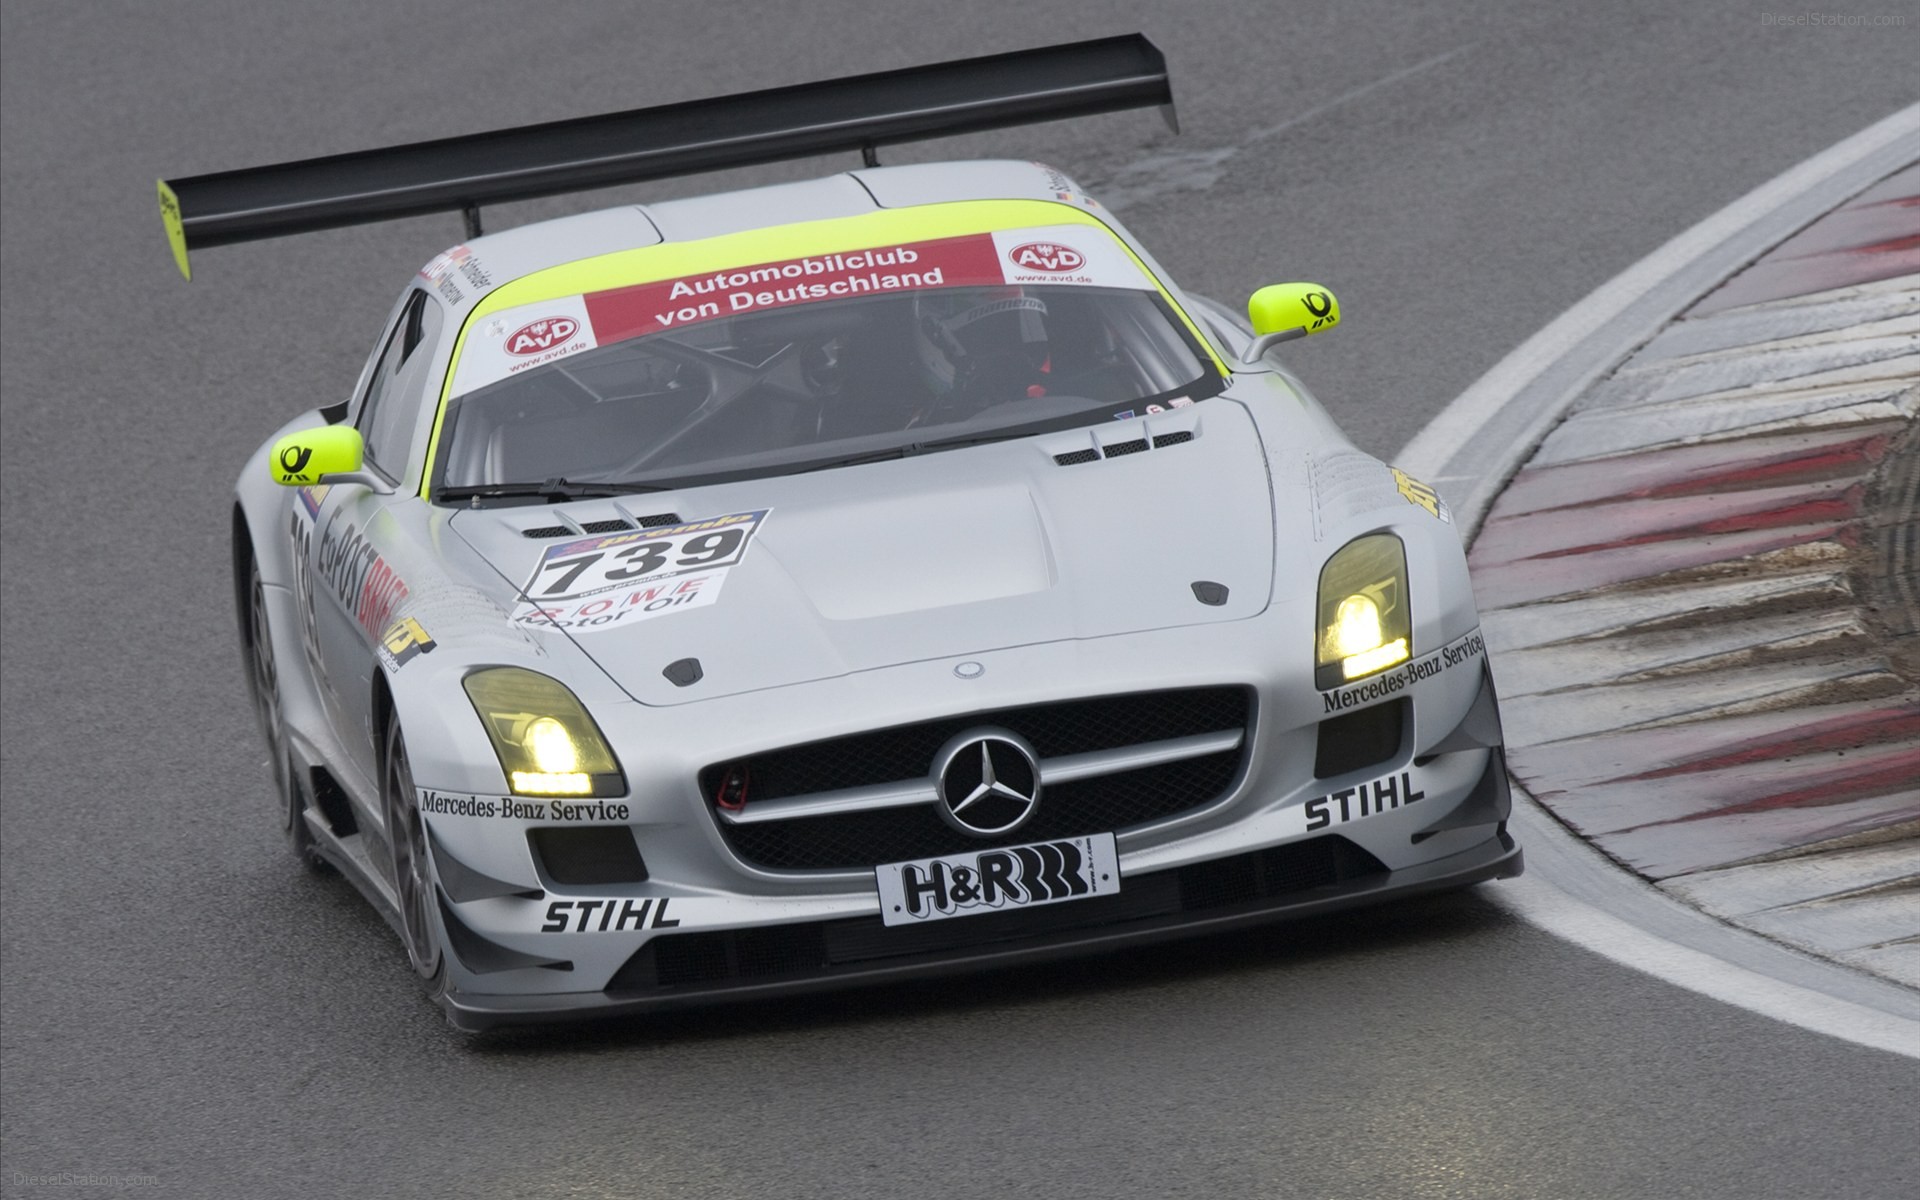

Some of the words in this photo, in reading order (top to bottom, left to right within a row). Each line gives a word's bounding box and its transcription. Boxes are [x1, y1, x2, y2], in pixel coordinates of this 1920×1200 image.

[669, 248, 918, 300] Automobilclub
[1019, 249, 1081, 270] AvD
[1014, 275, 1092, 283] www.avd.de
[655, 302, 719, 327] von
[732, 268, 943, 312] Deutschland
[513, 320, 576, 353] AvD
[509, 342, 587, 372] www.avd.de
[541, 528, 745, 596] 739
[514, 609, 632, 628] Motor
[643, 591, 698, 612] Oil
[1322, 657, 1442, 714] Mercedes-Benz
[1442, 634, 1483, 669] Service
[421, 790, 545, 820] Mercedes-Benz
[550, 799, 629, 821] Service
[1304, 772, 1425, 832] STIHL
[541, 898, 681, 933] STIHL
